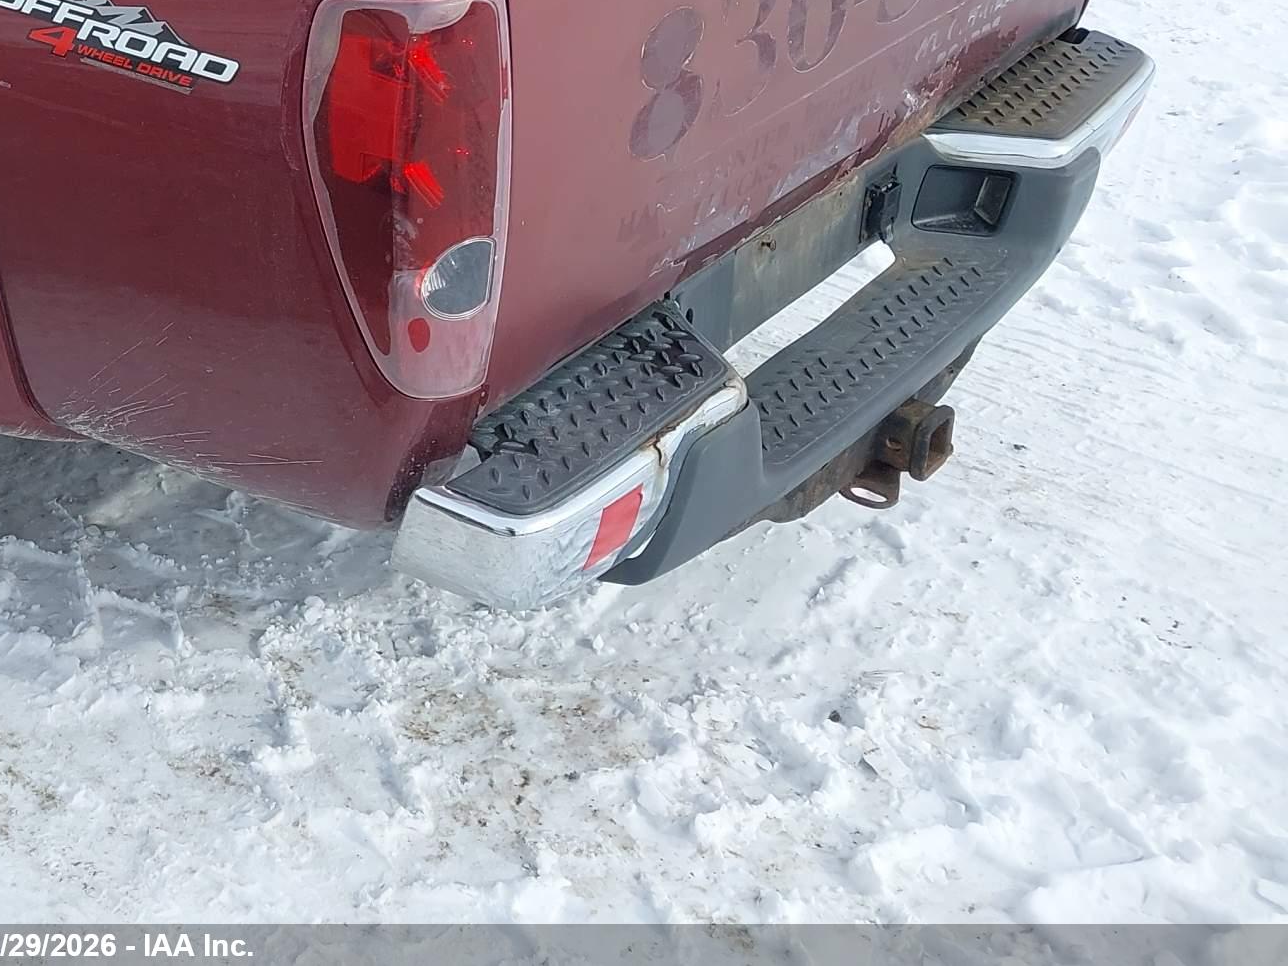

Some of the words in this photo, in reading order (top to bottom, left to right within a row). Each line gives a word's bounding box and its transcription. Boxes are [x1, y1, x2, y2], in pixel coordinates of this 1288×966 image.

[27, 25, 77, 58] 4
[76, 43, 133, 70] WHEEL
[135, 61, 194, 87] DRIVE
[75, 22, 240, 84] ROAD
